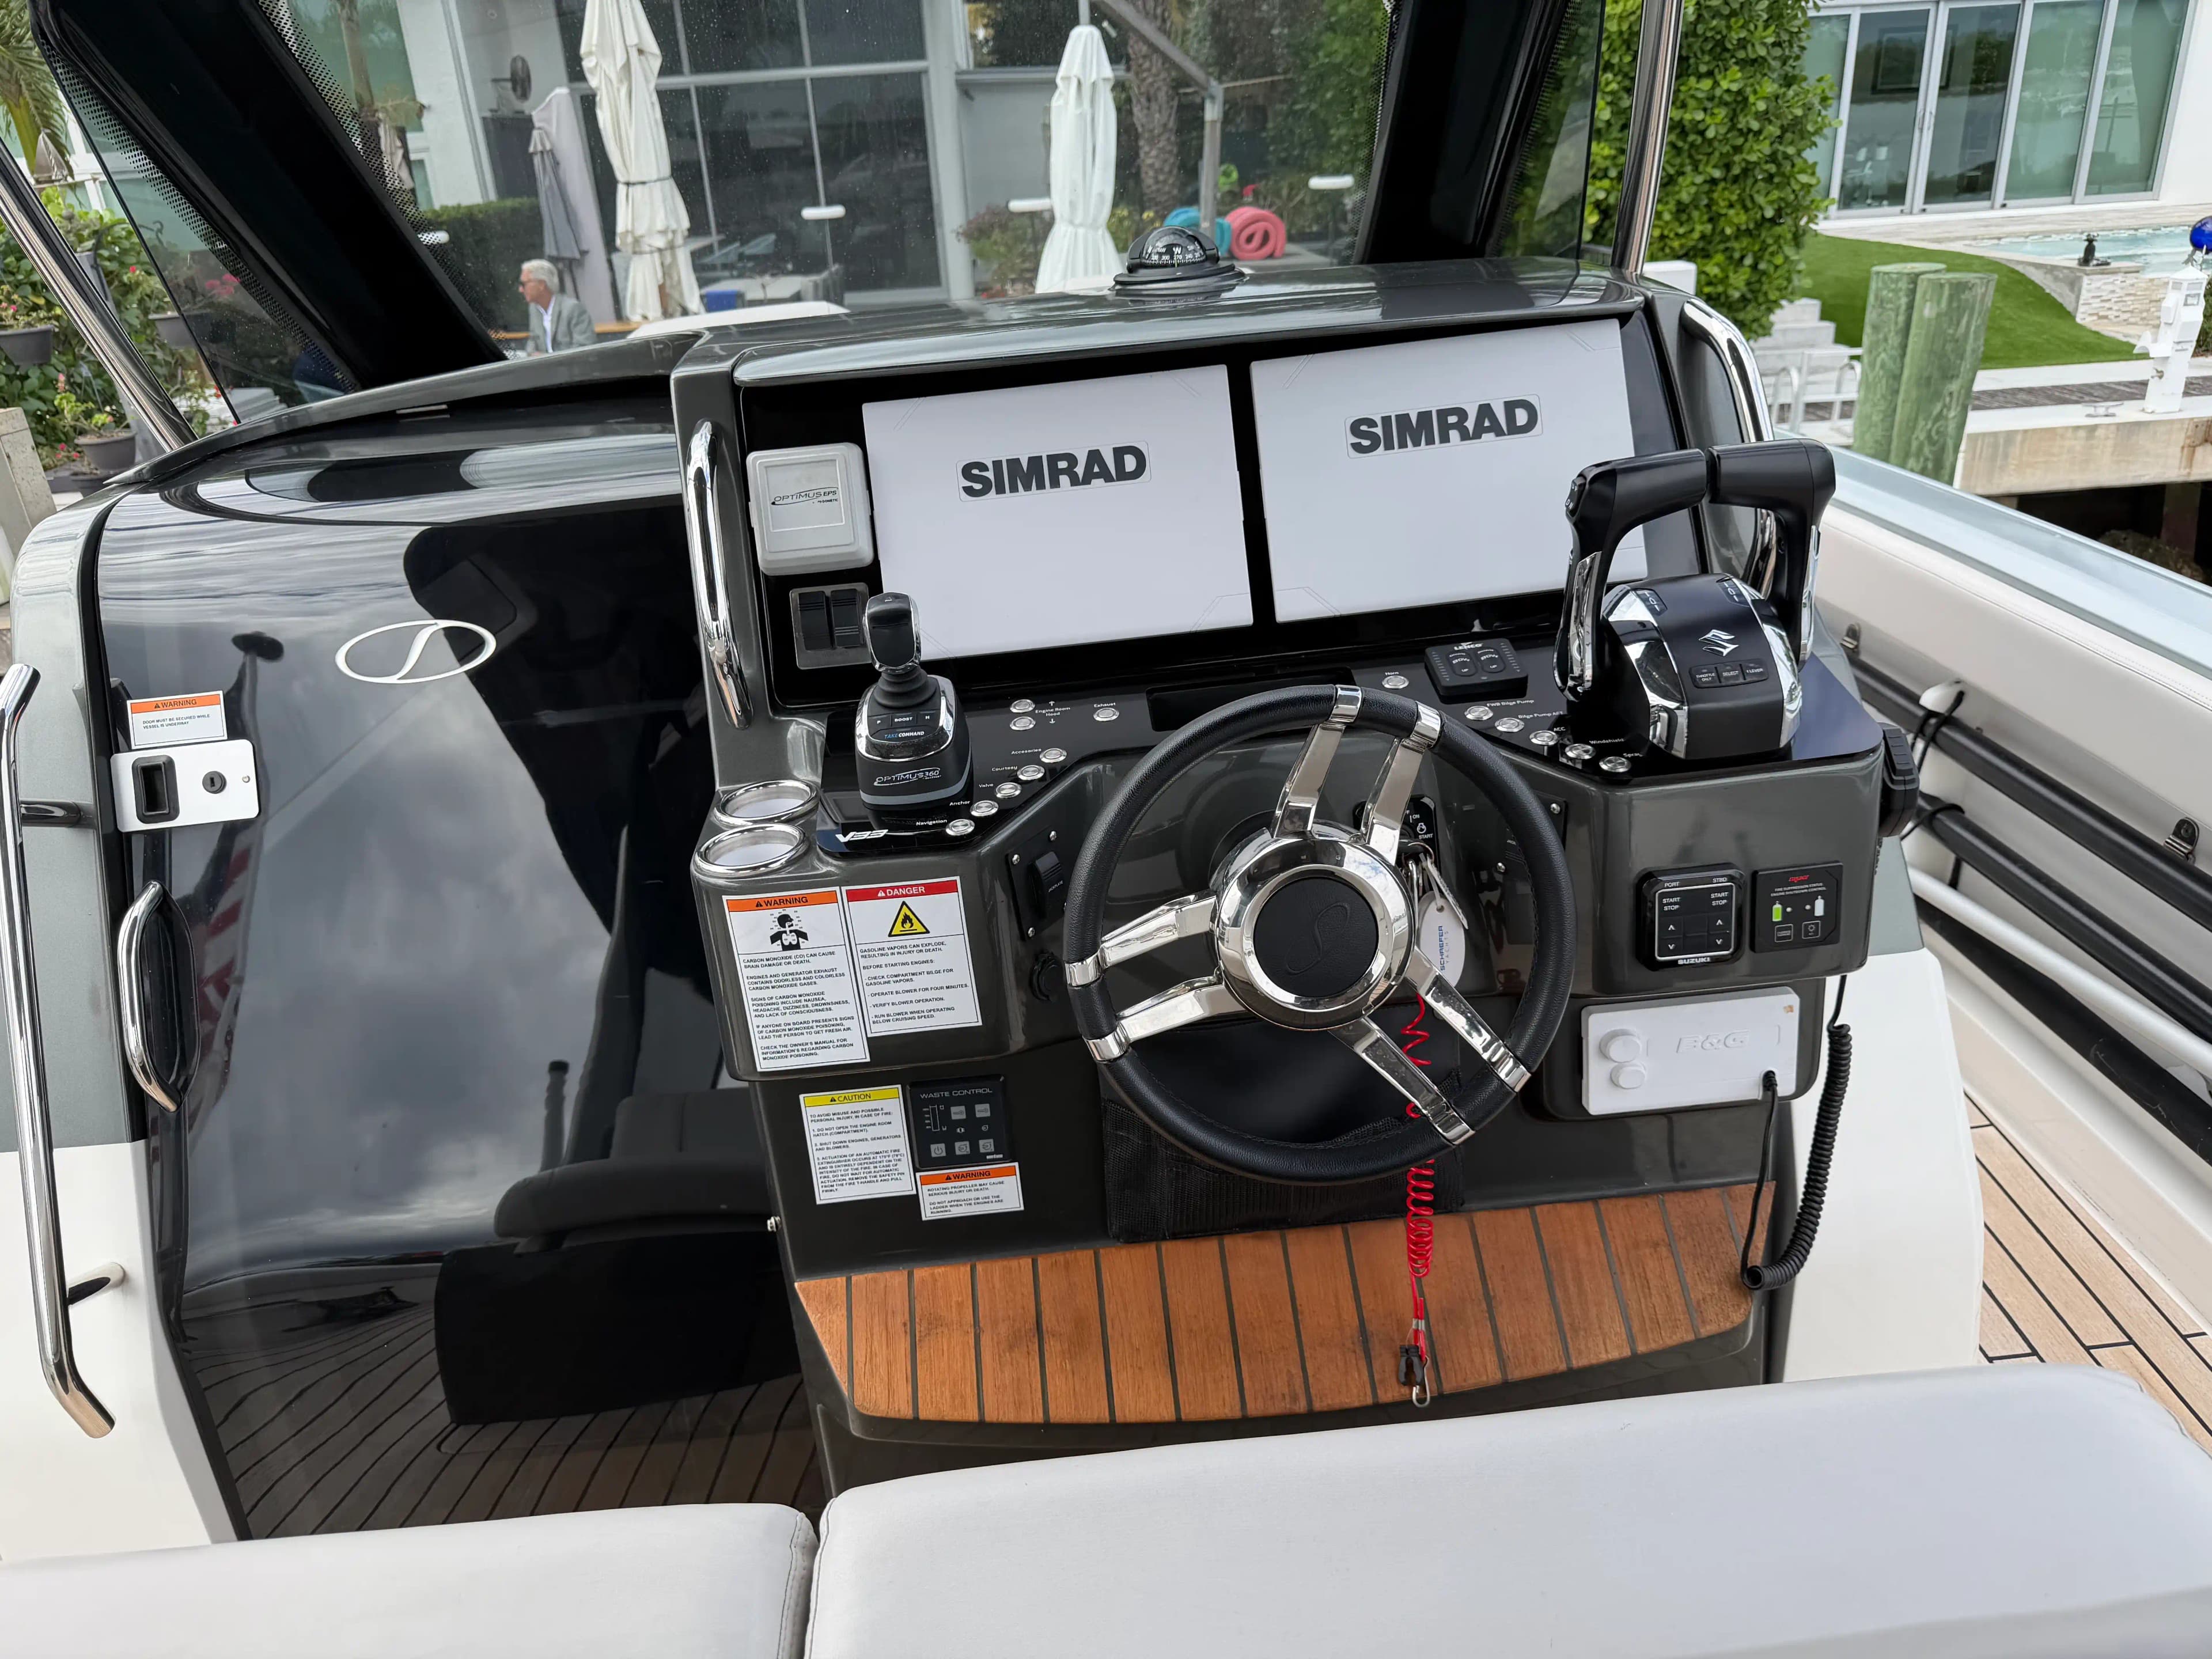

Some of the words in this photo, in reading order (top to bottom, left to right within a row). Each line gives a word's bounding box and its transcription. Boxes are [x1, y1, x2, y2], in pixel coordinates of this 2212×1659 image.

[1349, 398, 1539, 455] SIMRAD
[961, 445, 1147, 499] SIMRAD
[774, 492, 822, 502] OPTIMUS
[161, 699, 197, 709] WARNING
[887, 886, 925, 896] DANGER
[764, 896, 808, 907] WARNING
[1677, 957, 1711, 965] SUZUKI
[789, 1007, 833, 1015] CONSCIOUSNESS.
[838, 1093, 872, 1102] CAUTION
[920, 1091, 950, 1099] WASTE
[952, 1088, 993, 1096] CONTROL
[953, 1171, 991, 1180] WARNING
